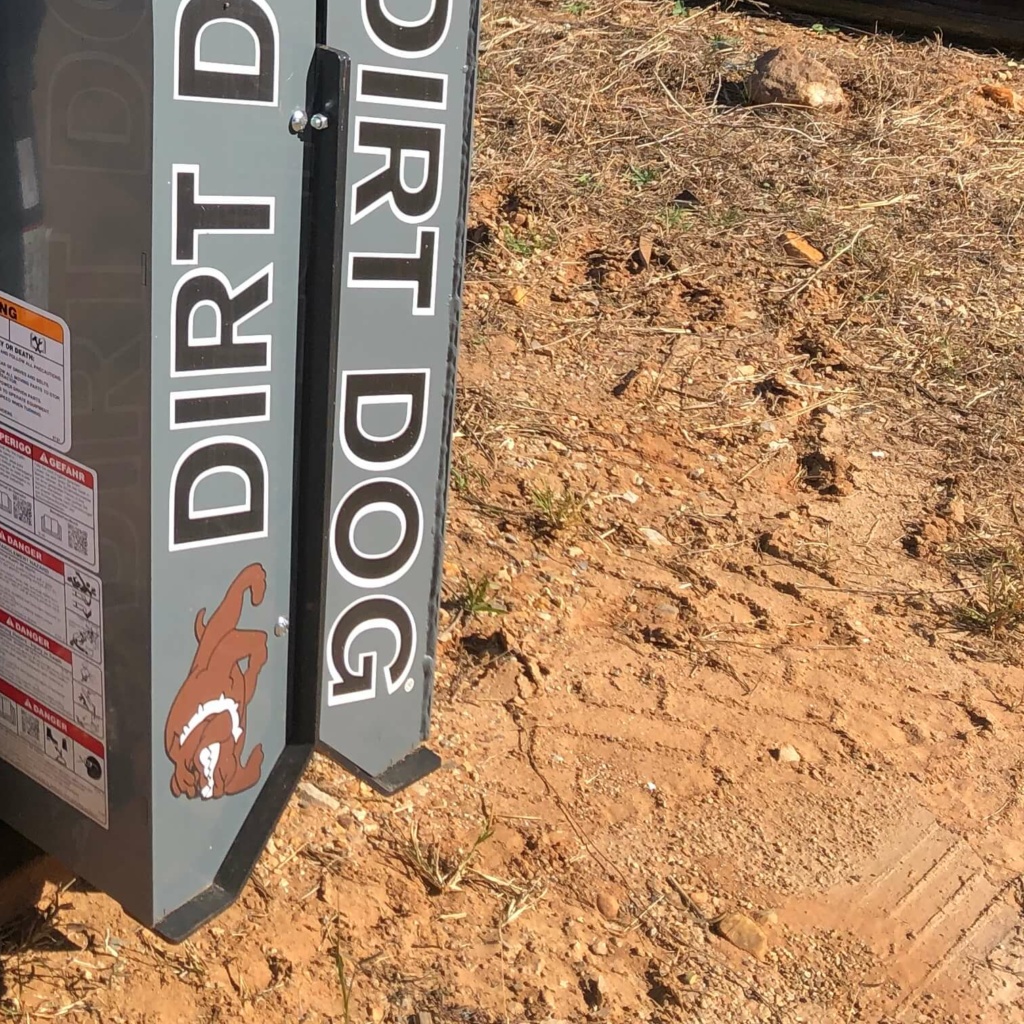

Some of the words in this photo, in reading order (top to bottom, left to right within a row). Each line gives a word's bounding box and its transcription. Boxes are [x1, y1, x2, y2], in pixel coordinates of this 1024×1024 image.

[5, 342, 13, 352] OR
[14, 346, 34, 362] DEATH:
[169, 163, 275, 551] DIRT
[49, 455, 85, 483] GEFAHR
[7, 535, 42, 561] DANGER
[326, 368, 430, 707] DOG
[15, 621, 49, 649] DANGER
[34, 704, 68, 731] DANGER
